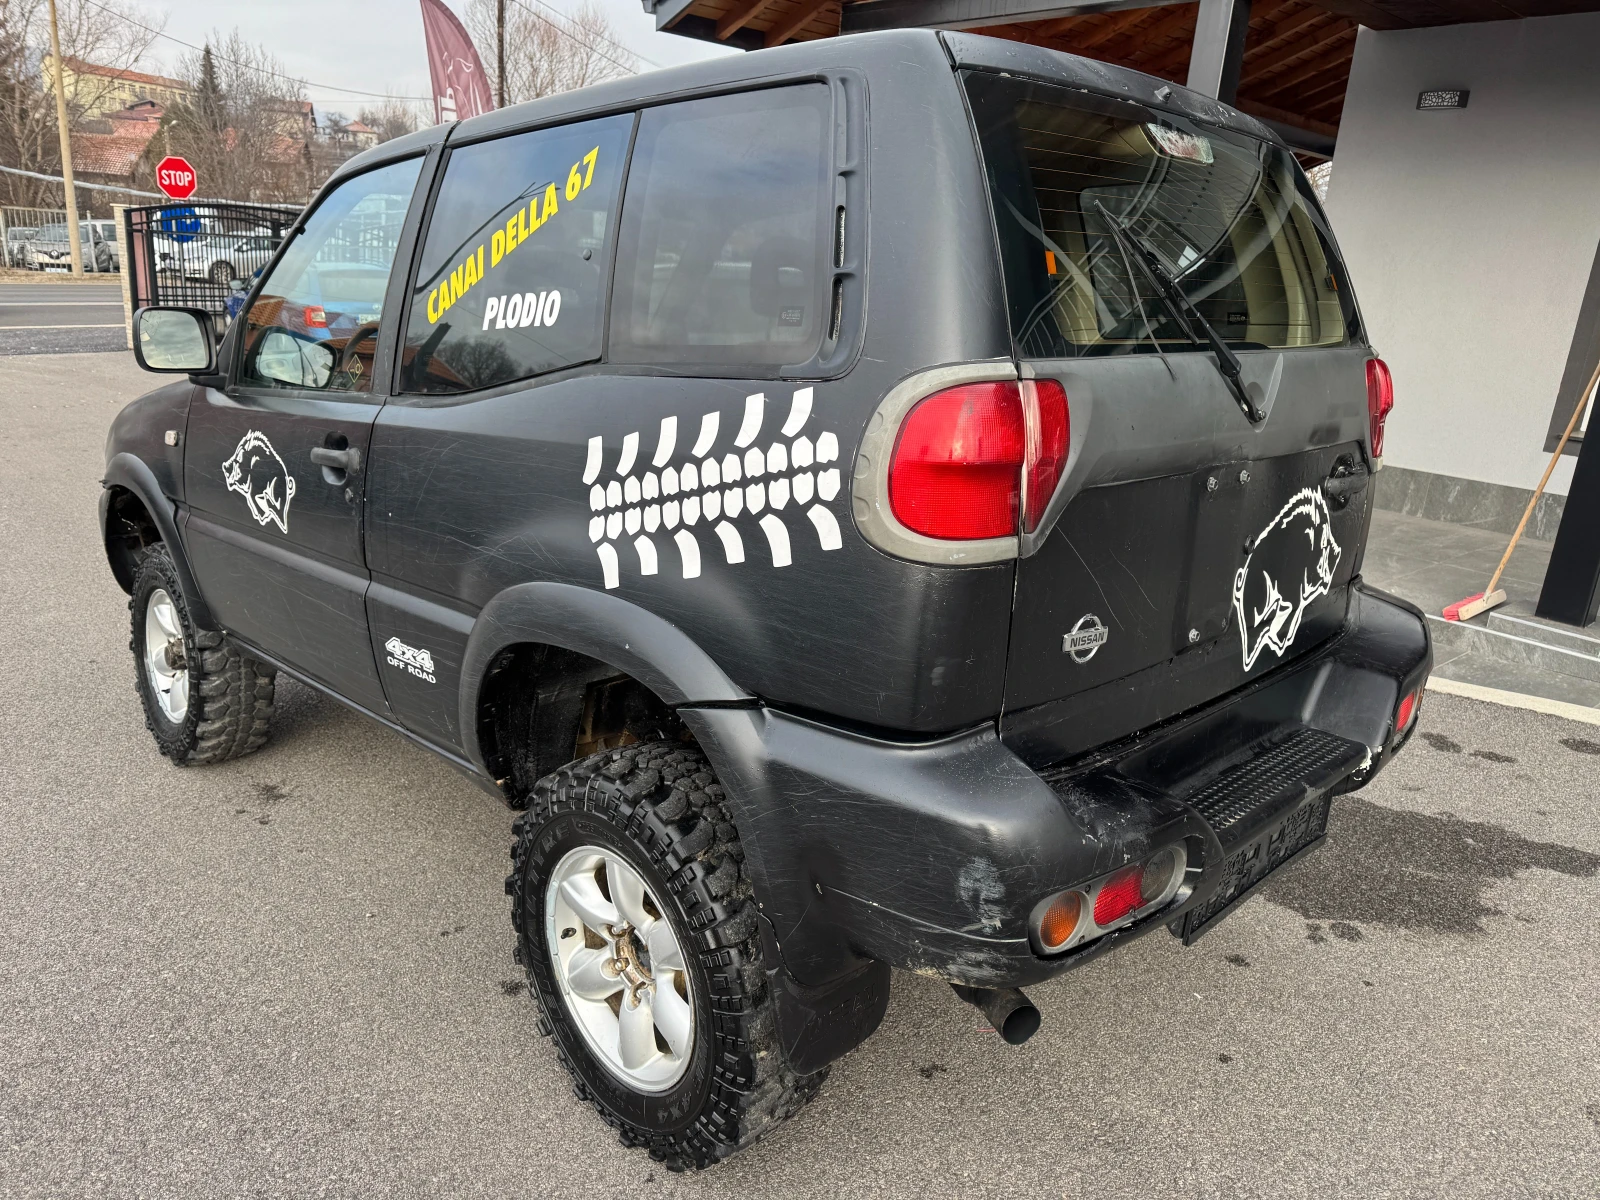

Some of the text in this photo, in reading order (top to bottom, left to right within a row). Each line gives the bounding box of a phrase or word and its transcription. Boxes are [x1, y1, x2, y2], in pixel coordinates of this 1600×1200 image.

[161, 169, 192, 187] STOP
[427, 145, 599, 325] CANAI DELLA 67
[482, 289, 562, 331] PLODIO
[1070, 631, 1105, 648] NISSAN
[387, 656, 436, 683] OFF ROAD
